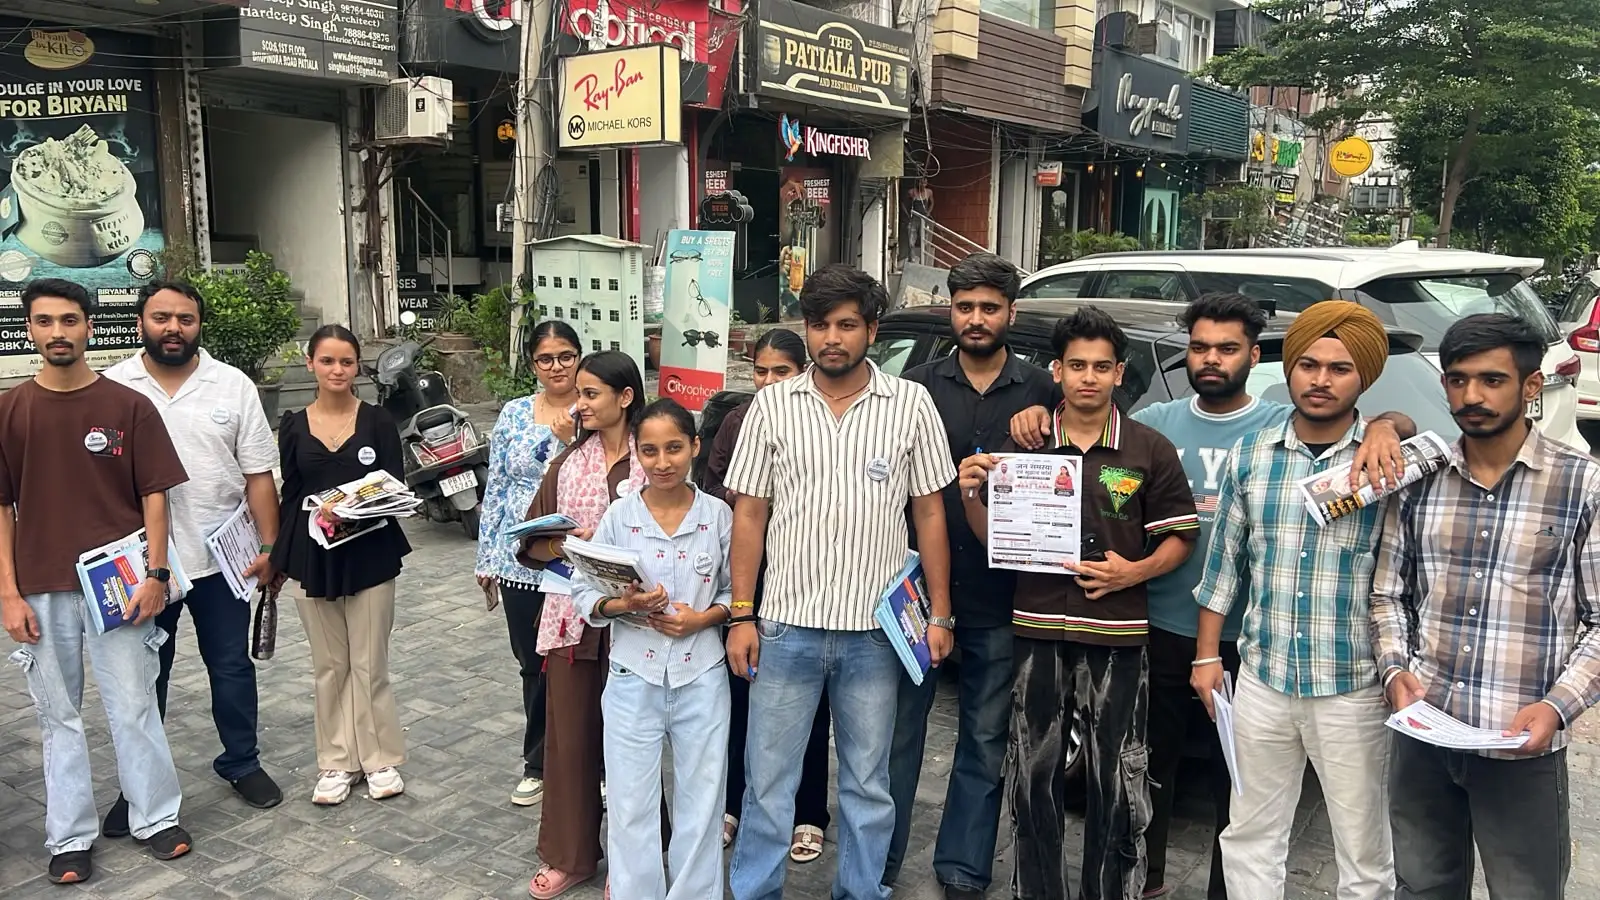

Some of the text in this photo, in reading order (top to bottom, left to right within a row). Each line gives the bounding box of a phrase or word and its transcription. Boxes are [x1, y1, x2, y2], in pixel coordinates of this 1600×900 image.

[300, 14, 338, 33] Singh
[332, 13, 380, 28] (Architect)
[829, 34, 853, 51] THE
[298, 57, 319, 71] PATIALA
[784, 38, 857, 79] PATIALA
[860, 56, 892, 86] PUB
[48, 82, 63, 94] IN
[67, 80, 104, 92] YOUR
[107, 79, 142, 91] LOVE
[818, 77, 830, 88] AND
[0, 94, 128, 117] FOR BIRYANI
[587, 119, 625, 131] MICHAEL
[627, 116, 652, 128] KORS
[805, 126, 871, 160] KINGFISHER
[803, 179, 830, 188] FRESHEST
[807, 187, 829, 198] BEER
[680, 235, 695, 244] BUY
[696, 236, 703, 245] A
